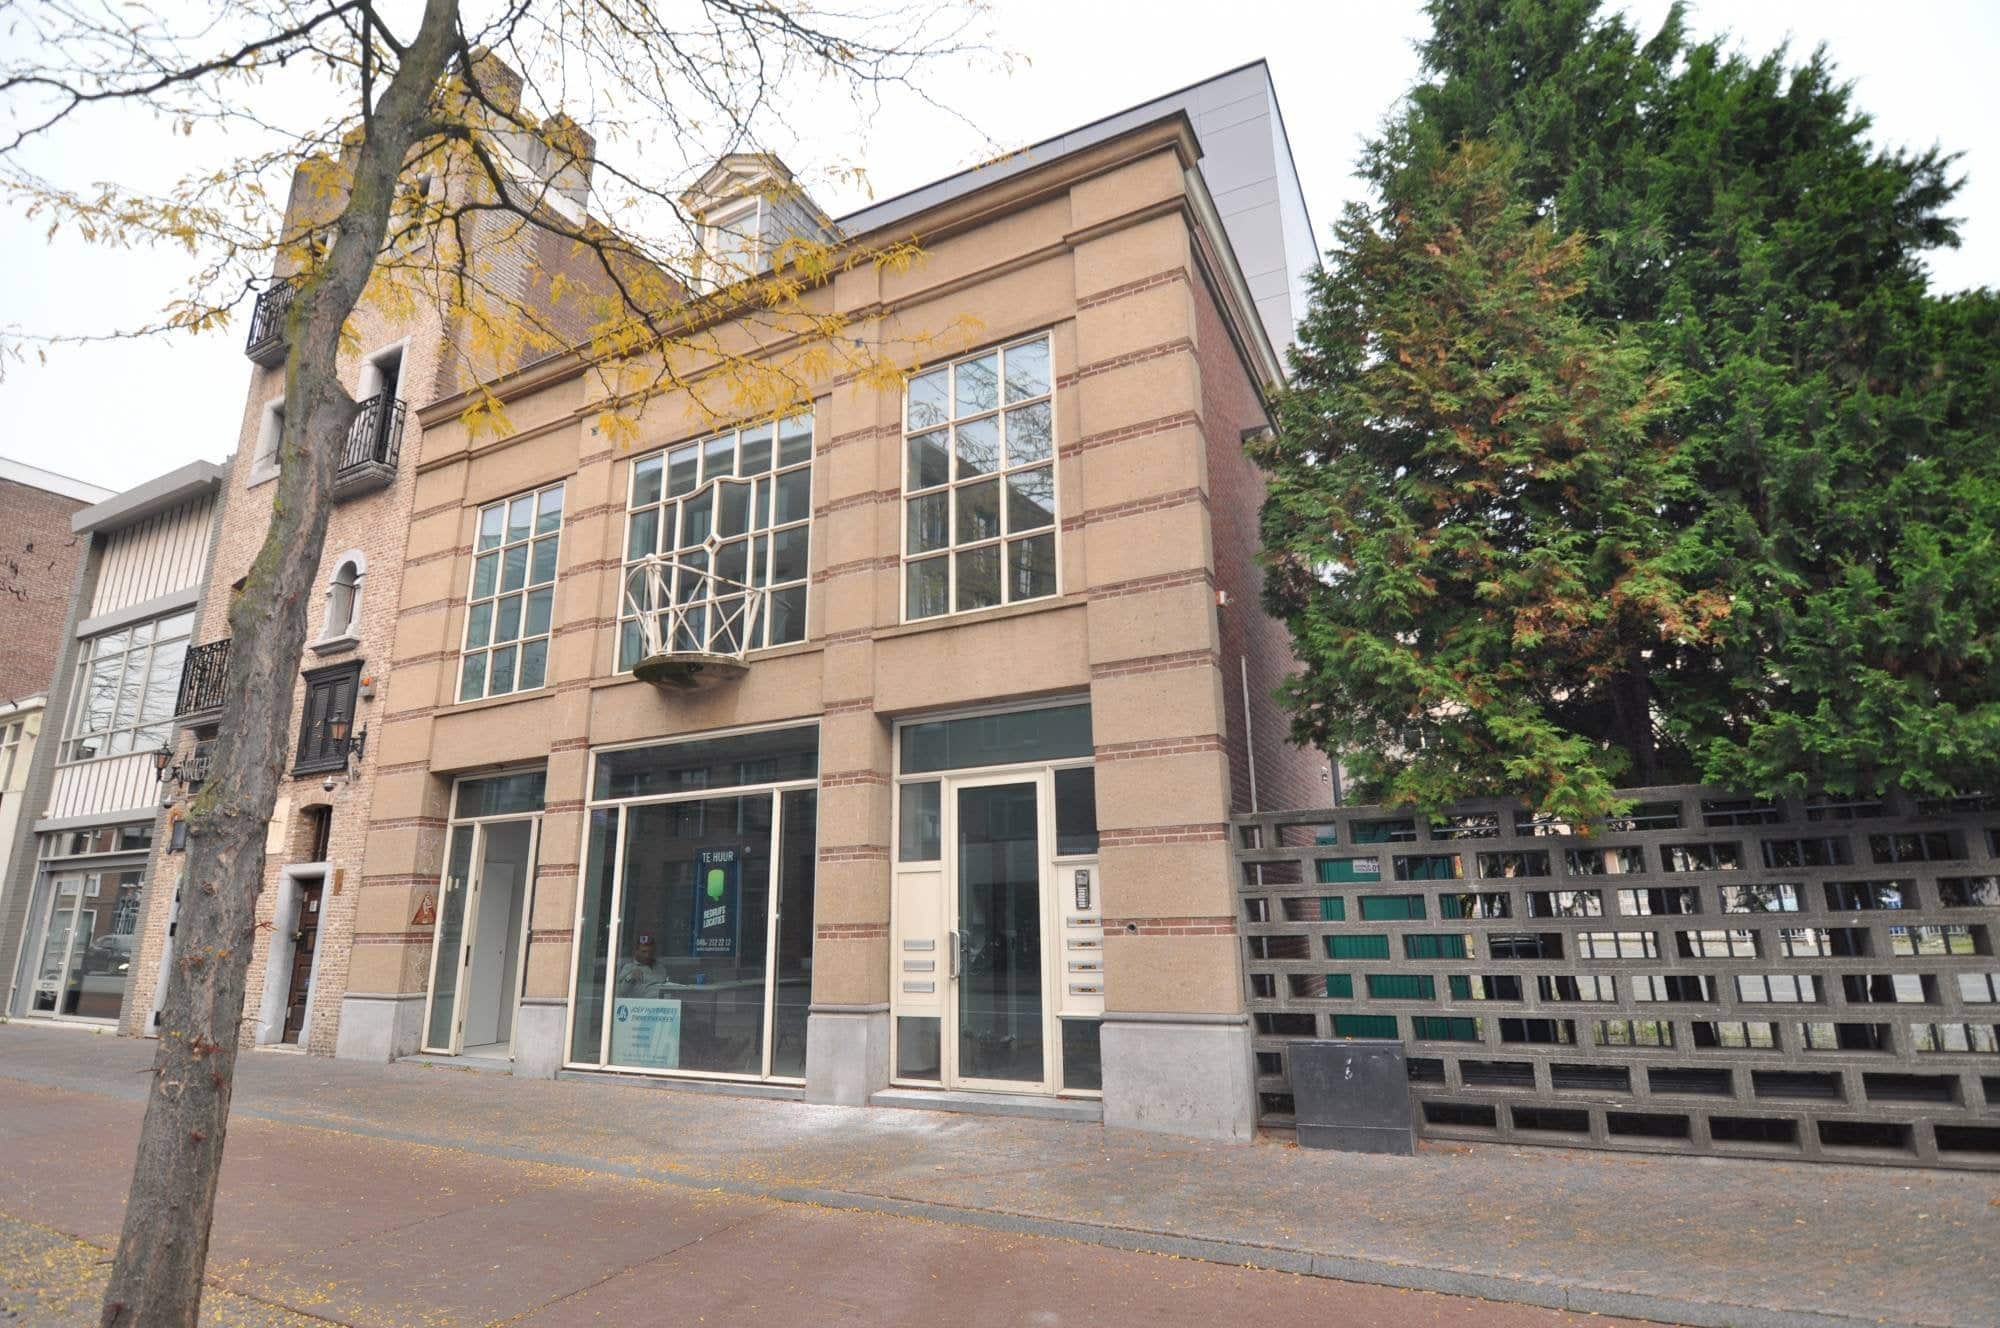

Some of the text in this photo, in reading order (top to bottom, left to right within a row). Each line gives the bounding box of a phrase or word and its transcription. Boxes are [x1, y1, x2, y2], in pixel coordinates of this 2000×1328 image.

[702, 851, 734, 863] TE HUUR
[702, 914, 727, 929] LOCATIES
